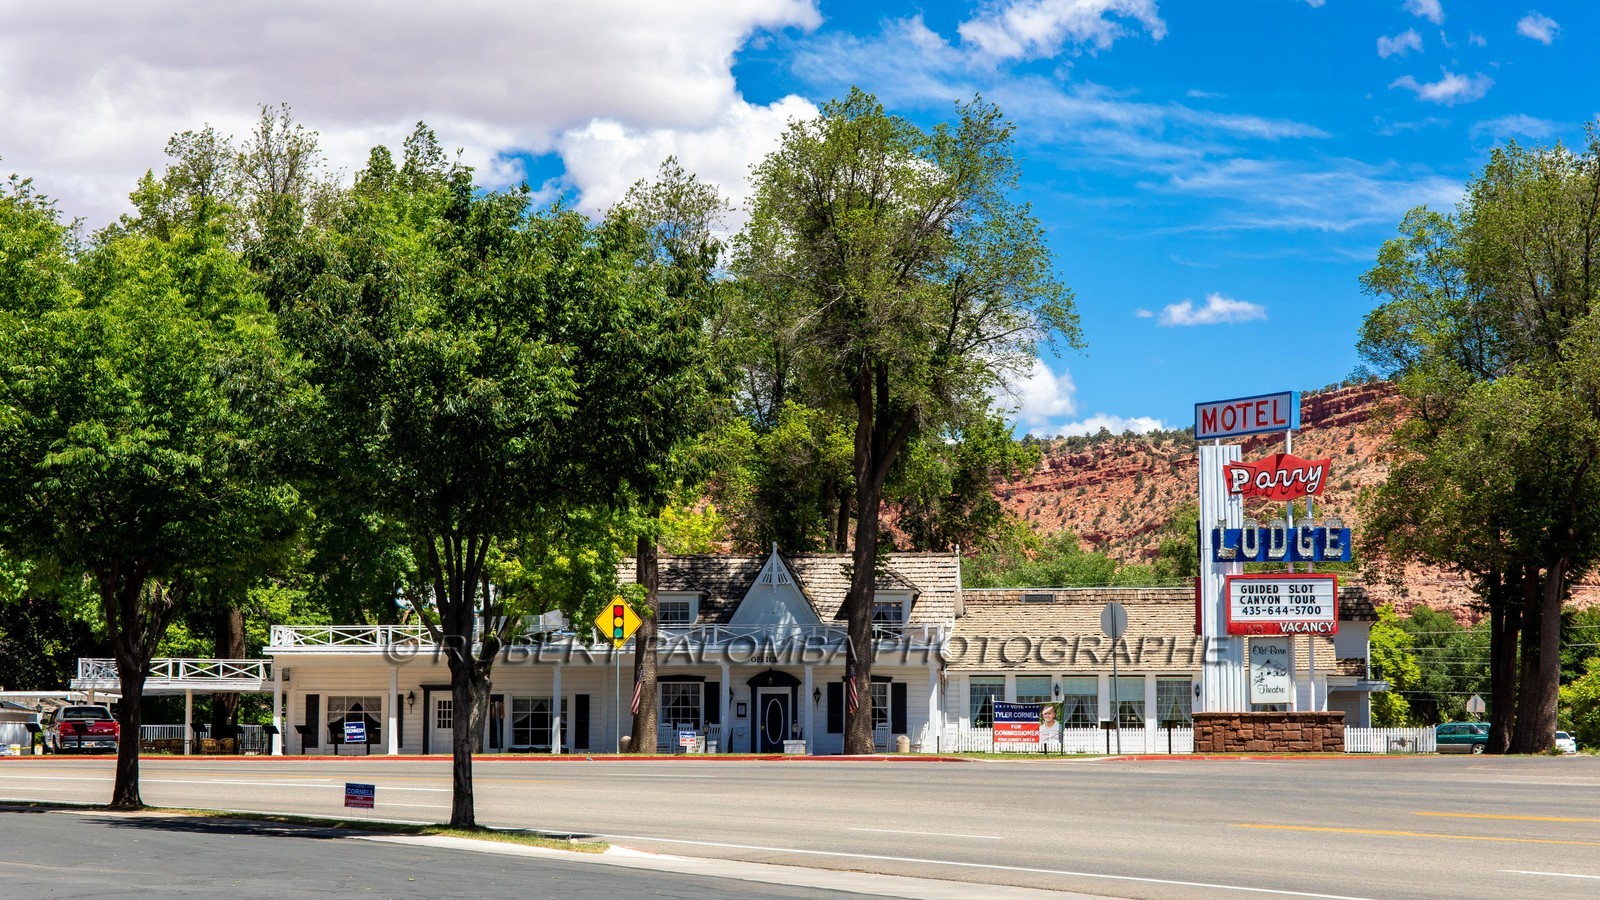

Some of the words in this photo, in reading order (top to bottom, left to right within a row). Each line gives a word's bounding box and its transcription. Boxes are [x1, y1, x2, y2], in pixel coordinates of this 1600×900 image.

[1202, 400, 1286, 434] MOTEL
[1230, 465, 1323, 494] Parry
[1217, 518, 1344, 559] LODGE
[1240, 584, 1279, 594] GUIDED
[1288, 584, 1314, 594] SLOT
[1239, 595, 1280, 605] CANYON
[1288, 595, 1316, 605] TOUR
[1241, 605, 1322, 616] 435-644-5700
[1279, 622, 1334, 632] VACANCY
[1252, 645, 1267, 655] Old
[1268, 645, 1287, 655] Barn
[1257, 684, 1285, 694] Theatre
[346, 788, 374, 796] CORNELL
